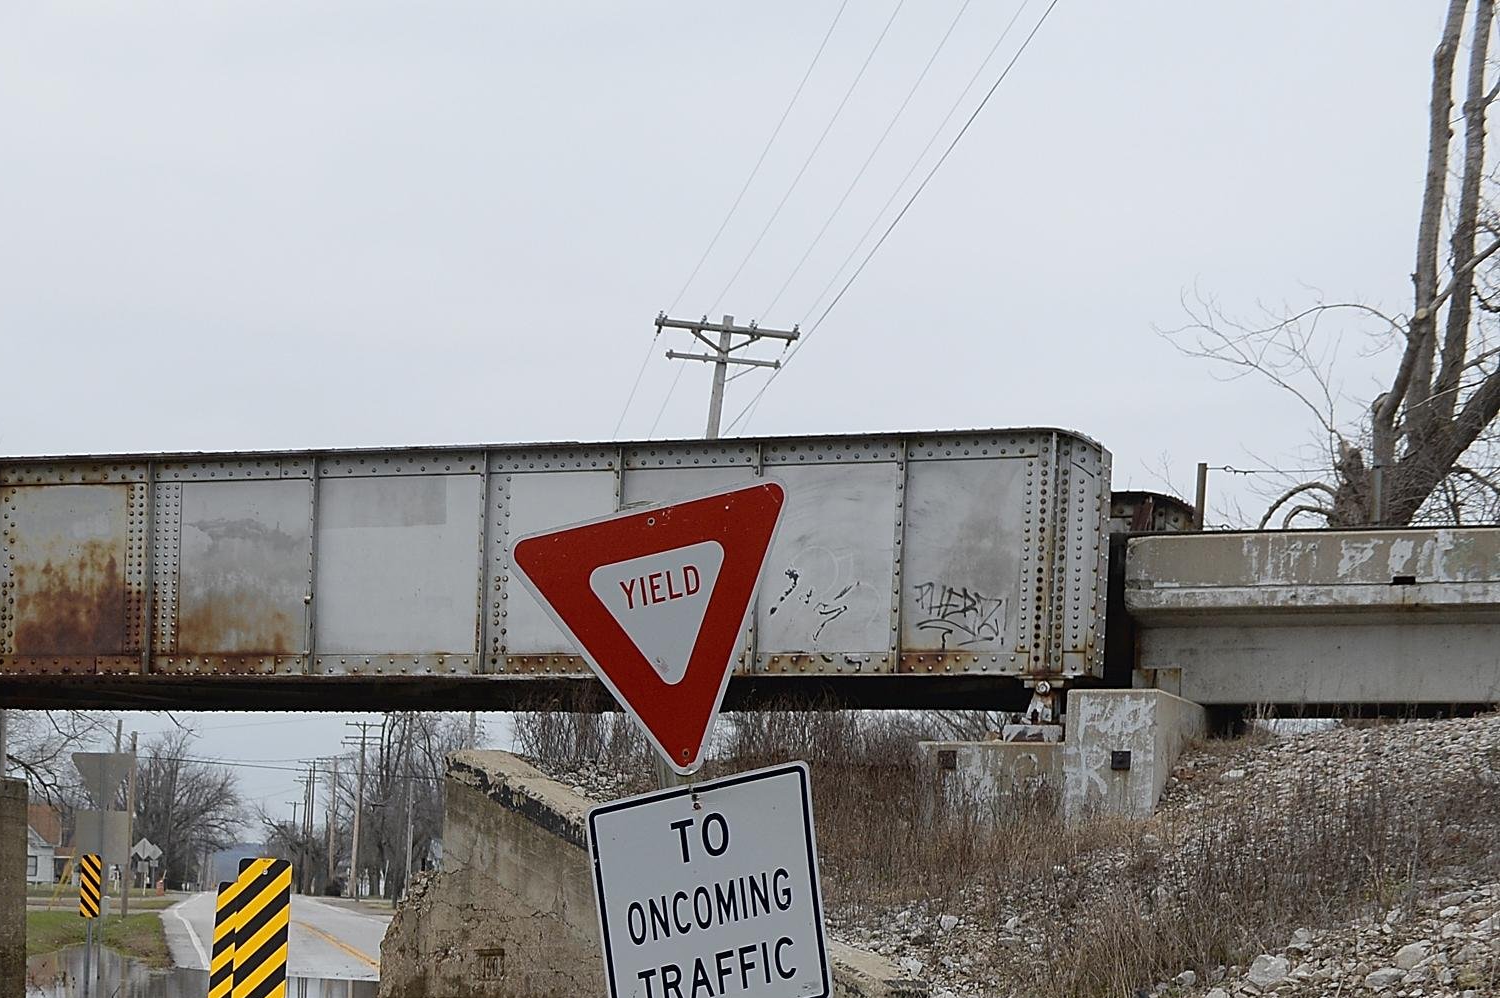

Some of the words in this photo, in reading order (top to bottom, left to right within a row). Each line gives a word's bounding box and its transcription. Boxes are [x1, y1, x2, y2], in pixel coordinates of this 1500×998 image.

[619, 565, 700, 609] YIELD
[670, 812, 730, 863] TO
[627, 868, 792, 946] ONCOMING
